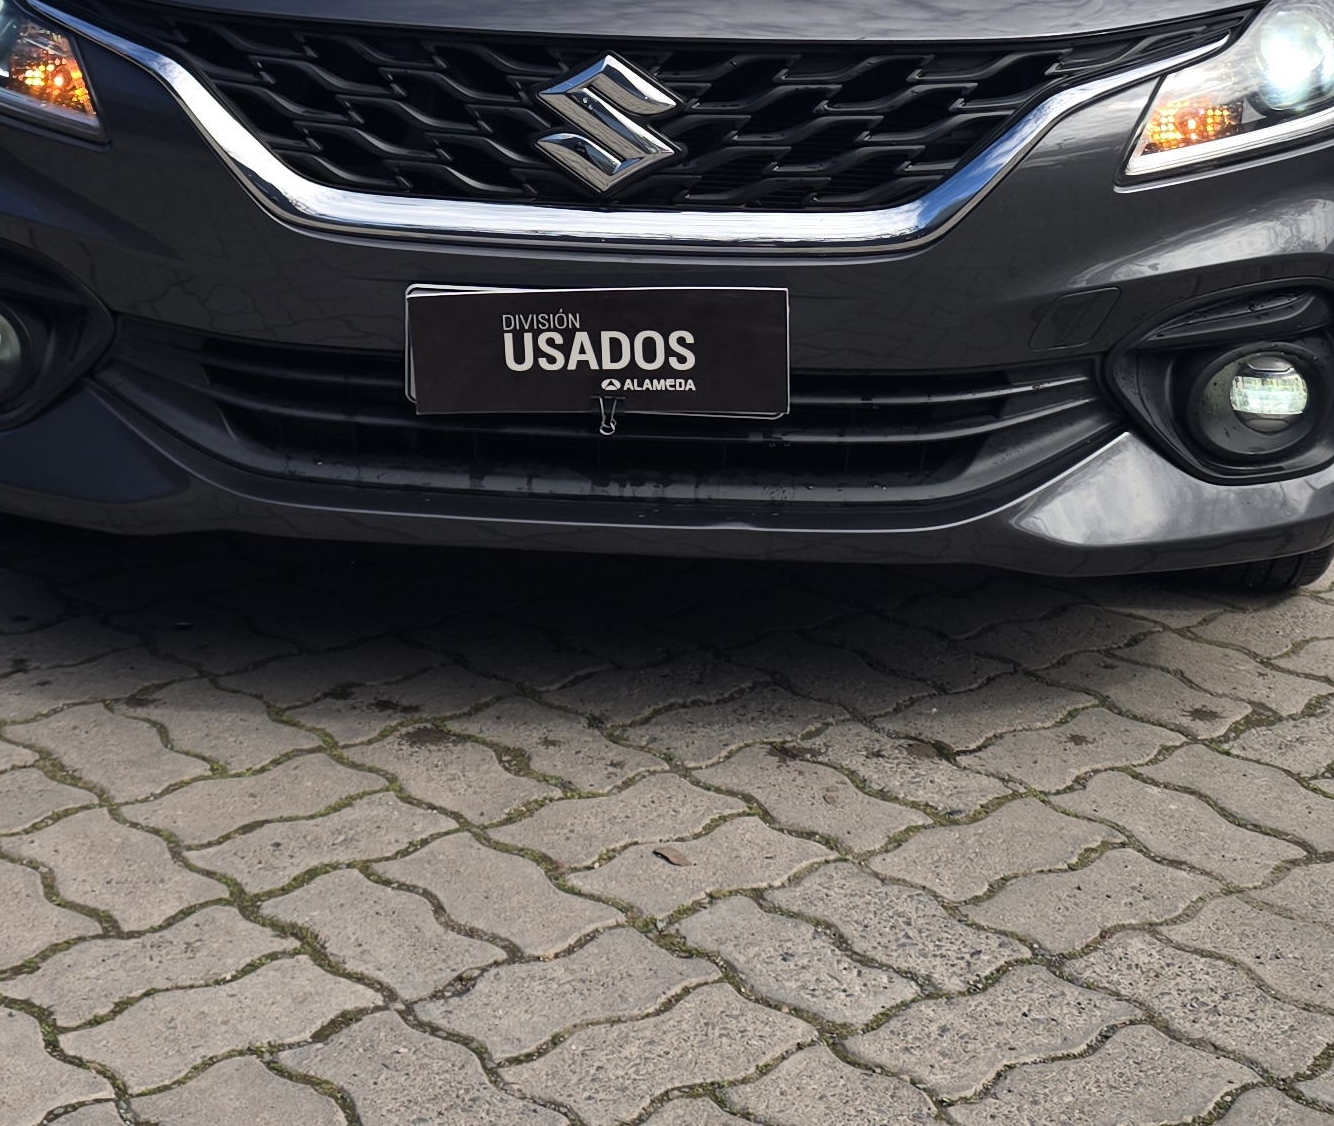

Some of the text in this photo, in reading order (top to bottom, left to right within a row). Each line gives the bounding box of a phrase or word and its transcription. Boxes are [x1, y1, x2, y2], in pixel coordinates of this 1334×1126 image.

[502, 309, 580, 330] DIVISIÓN
[503, 330, 696, 371] USADOS
[623, 378, 696, 391] ALAMEDA
